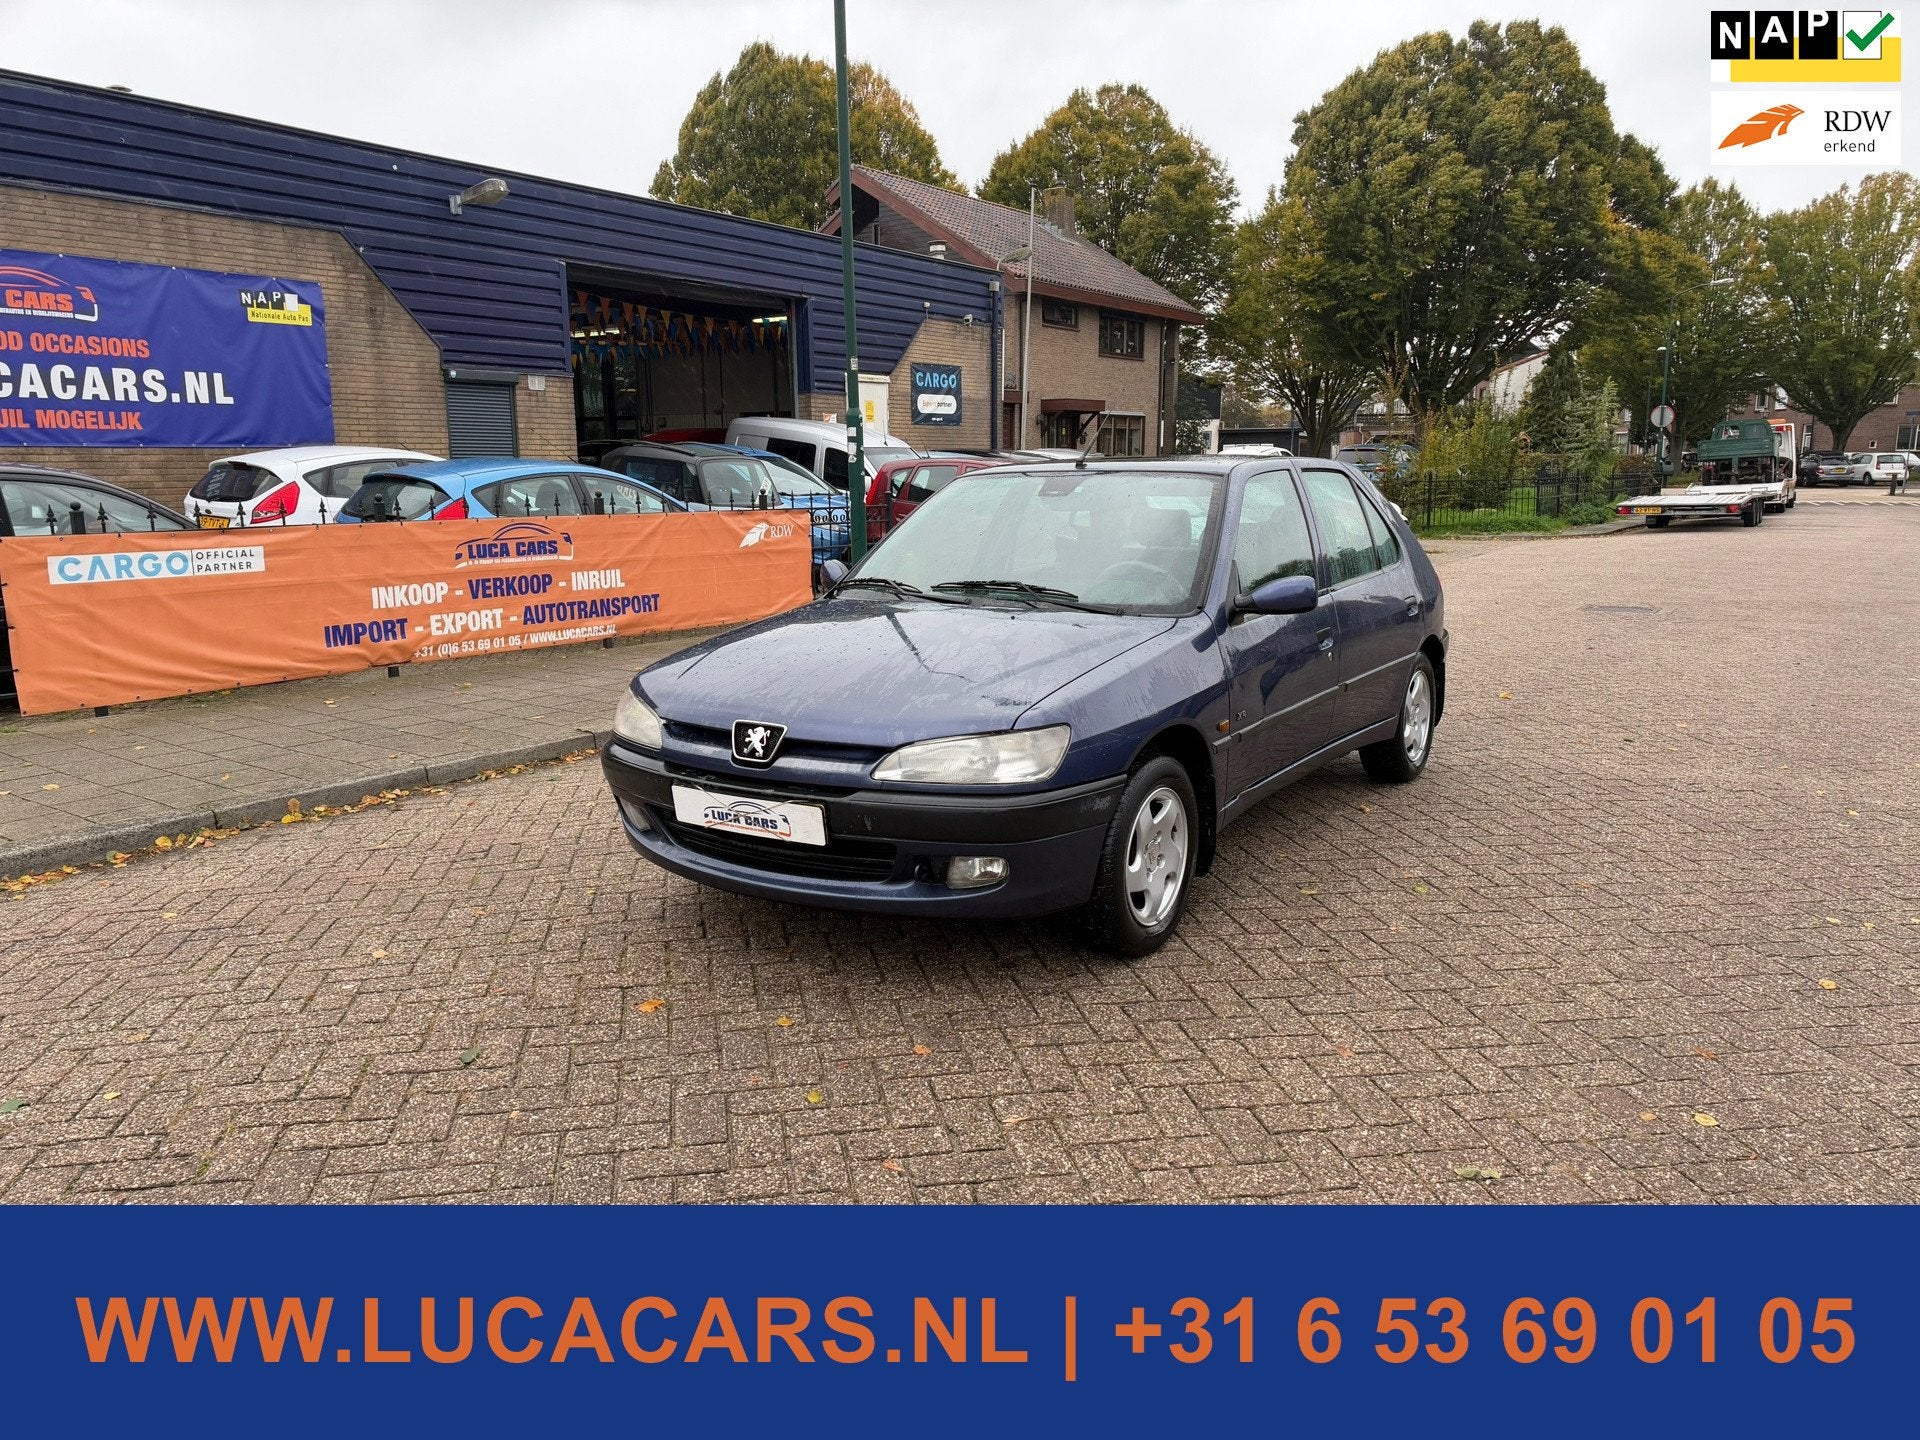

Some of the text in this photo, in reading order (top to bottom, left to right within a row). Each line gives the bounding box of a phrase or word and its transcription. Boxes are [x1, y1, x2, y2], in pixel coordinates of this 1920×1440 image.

[5, 289, 74, 311] CARS
[240, 291, 281, 305] NAP
[251, 310, 281, 320] Nationale
[298, 314, 309, 322] Pas
[30, 332, 150, 358] OCCASIONS
[916, 371, 957, 388] CARGO
[35, 409, 144, 430] MOGELIJK
[770, 524, 794, 538] RDW
[195, 548, 255, 560] OFFICIAL
[467, 540, 558, 559] LUCA CARS
[57, 551, 190, 582] CARGO
[196, 561, 253, 573] PARTNER
[371, 581, 449, 609] INKOOP
[467, 573, 553, 600] VERKOOP
[570, 568, 626, 591] INRUIL
[324, 618, 409, 648] IMPORT
[430, 608, 504, 636] EXPORT
[522, 593, 660, 625] AUTOTRANSPORT
[414, 645, 434, 658] +31
[437, 642, 459, 657] (0)6
[461, 641, 475, 653] 53
[477, 639, 491, 651] 69
[493, 637, 506, 649] 01
[508, 635, 521, 647] 05
[529, 624, 618, 644] WWW.LUCACARS.NL
[711, 809, 741, 824] LUCA
[744, 815, 778, 830] CARS
